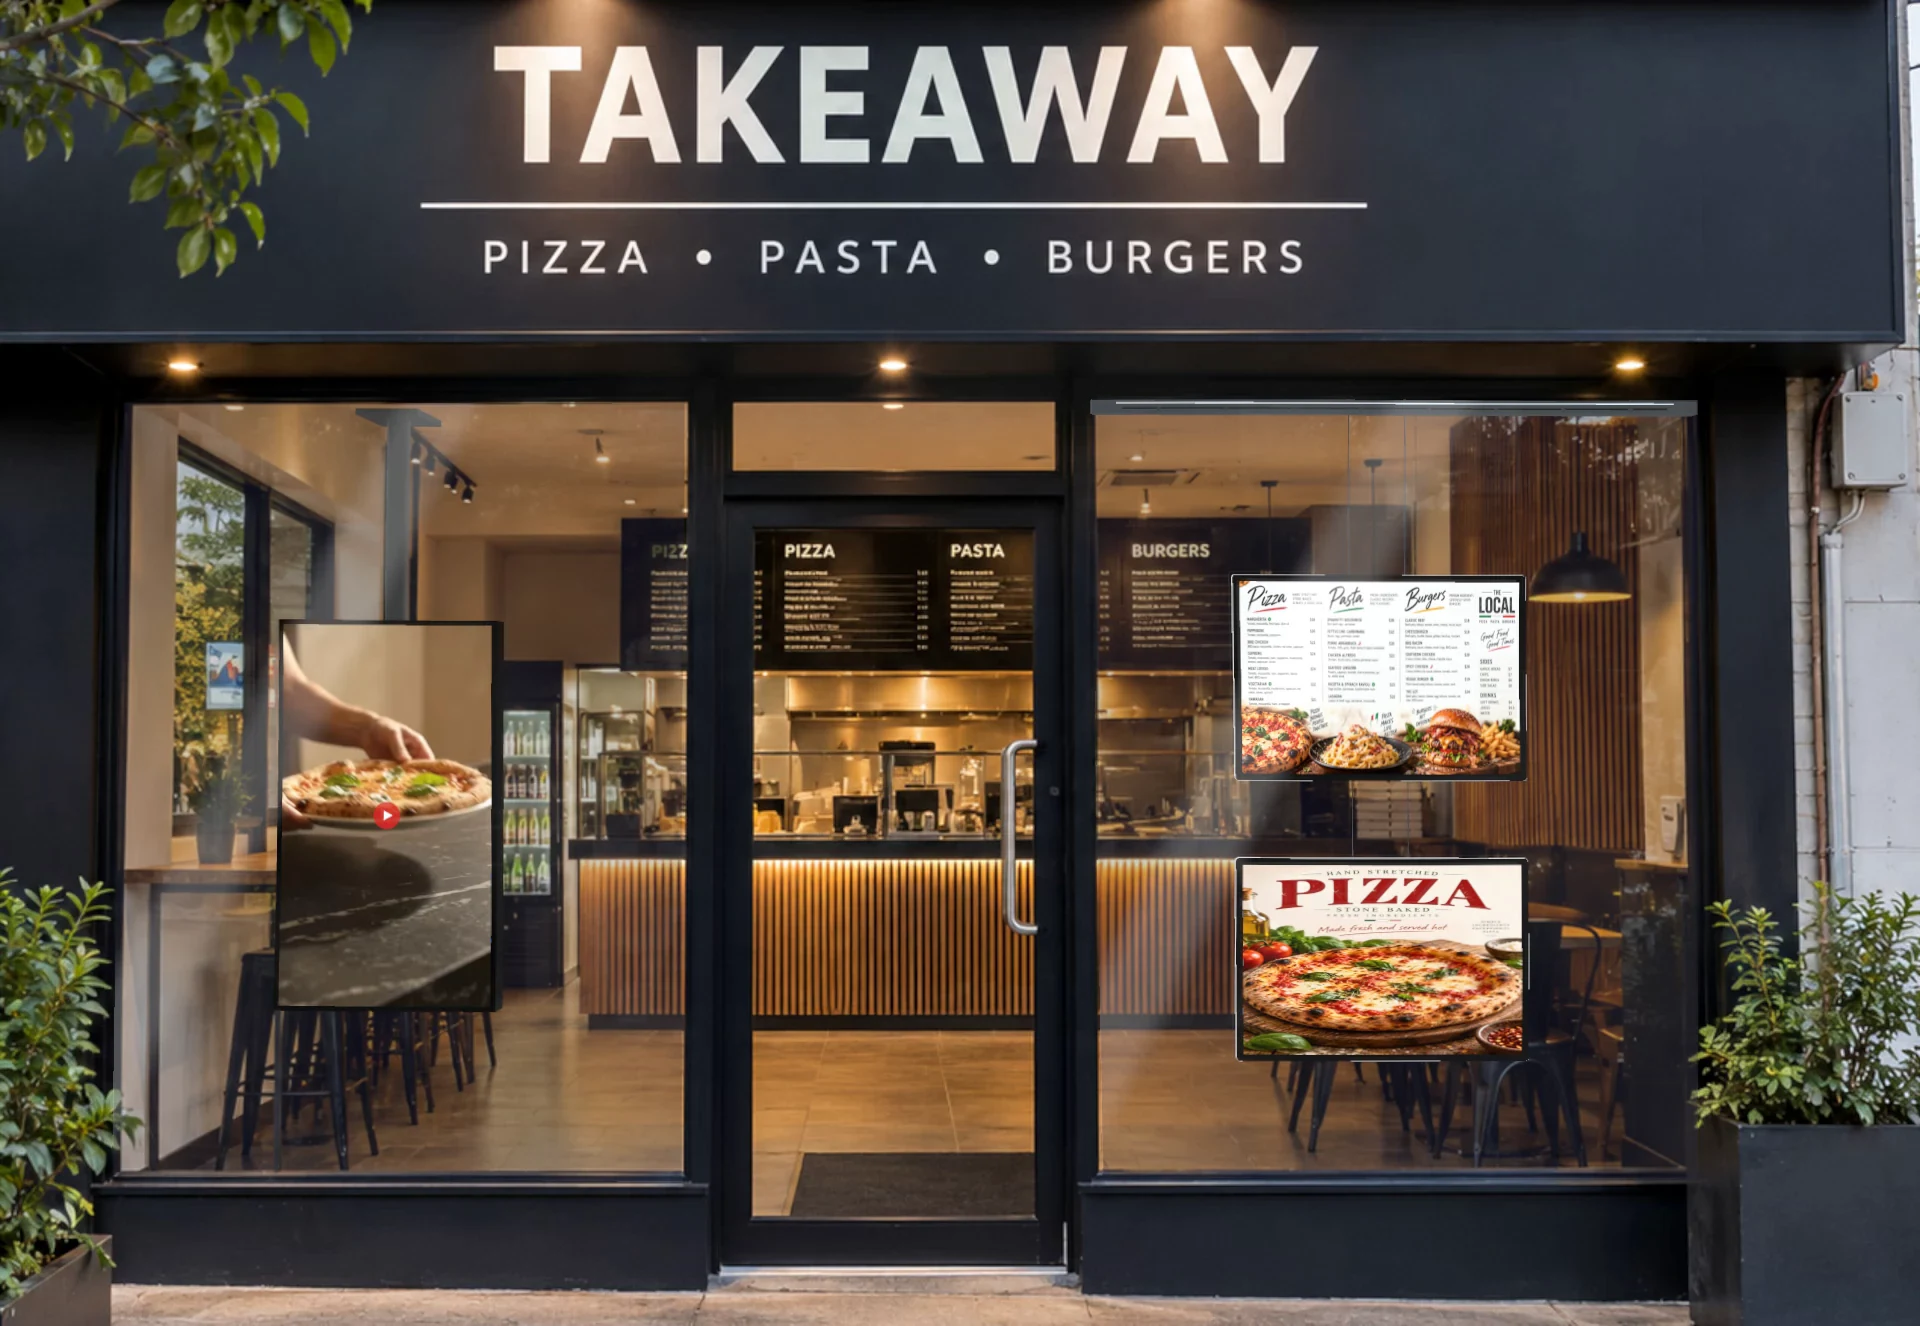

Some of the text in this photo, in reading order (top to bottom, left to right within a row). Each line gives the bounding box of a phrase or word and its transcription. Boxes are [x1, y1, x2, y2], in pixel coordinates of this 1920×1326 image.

[494, 45, 1318, 164] TAKEAWAY
[483, 239, 1305, 275] PIZZA PASTA BURGERS
[784, 543, 835, 559] PIZZA
[950, 543, 1005, 558] PASTA
[1132, 543, 1210, 558] BURGERS
[1247, 585, 1287, 612] Pizza
[1329, 586, 1364, 610] Pasta
[1404, 586, 1446, 612] Burgers
[1479, 596, 1516, 614] LOCAL
[1276, 878, 1491, 910] PIZZA
[1318, 925, 1345, 933] Made
[1350, 924, 1372, 932] fresh
